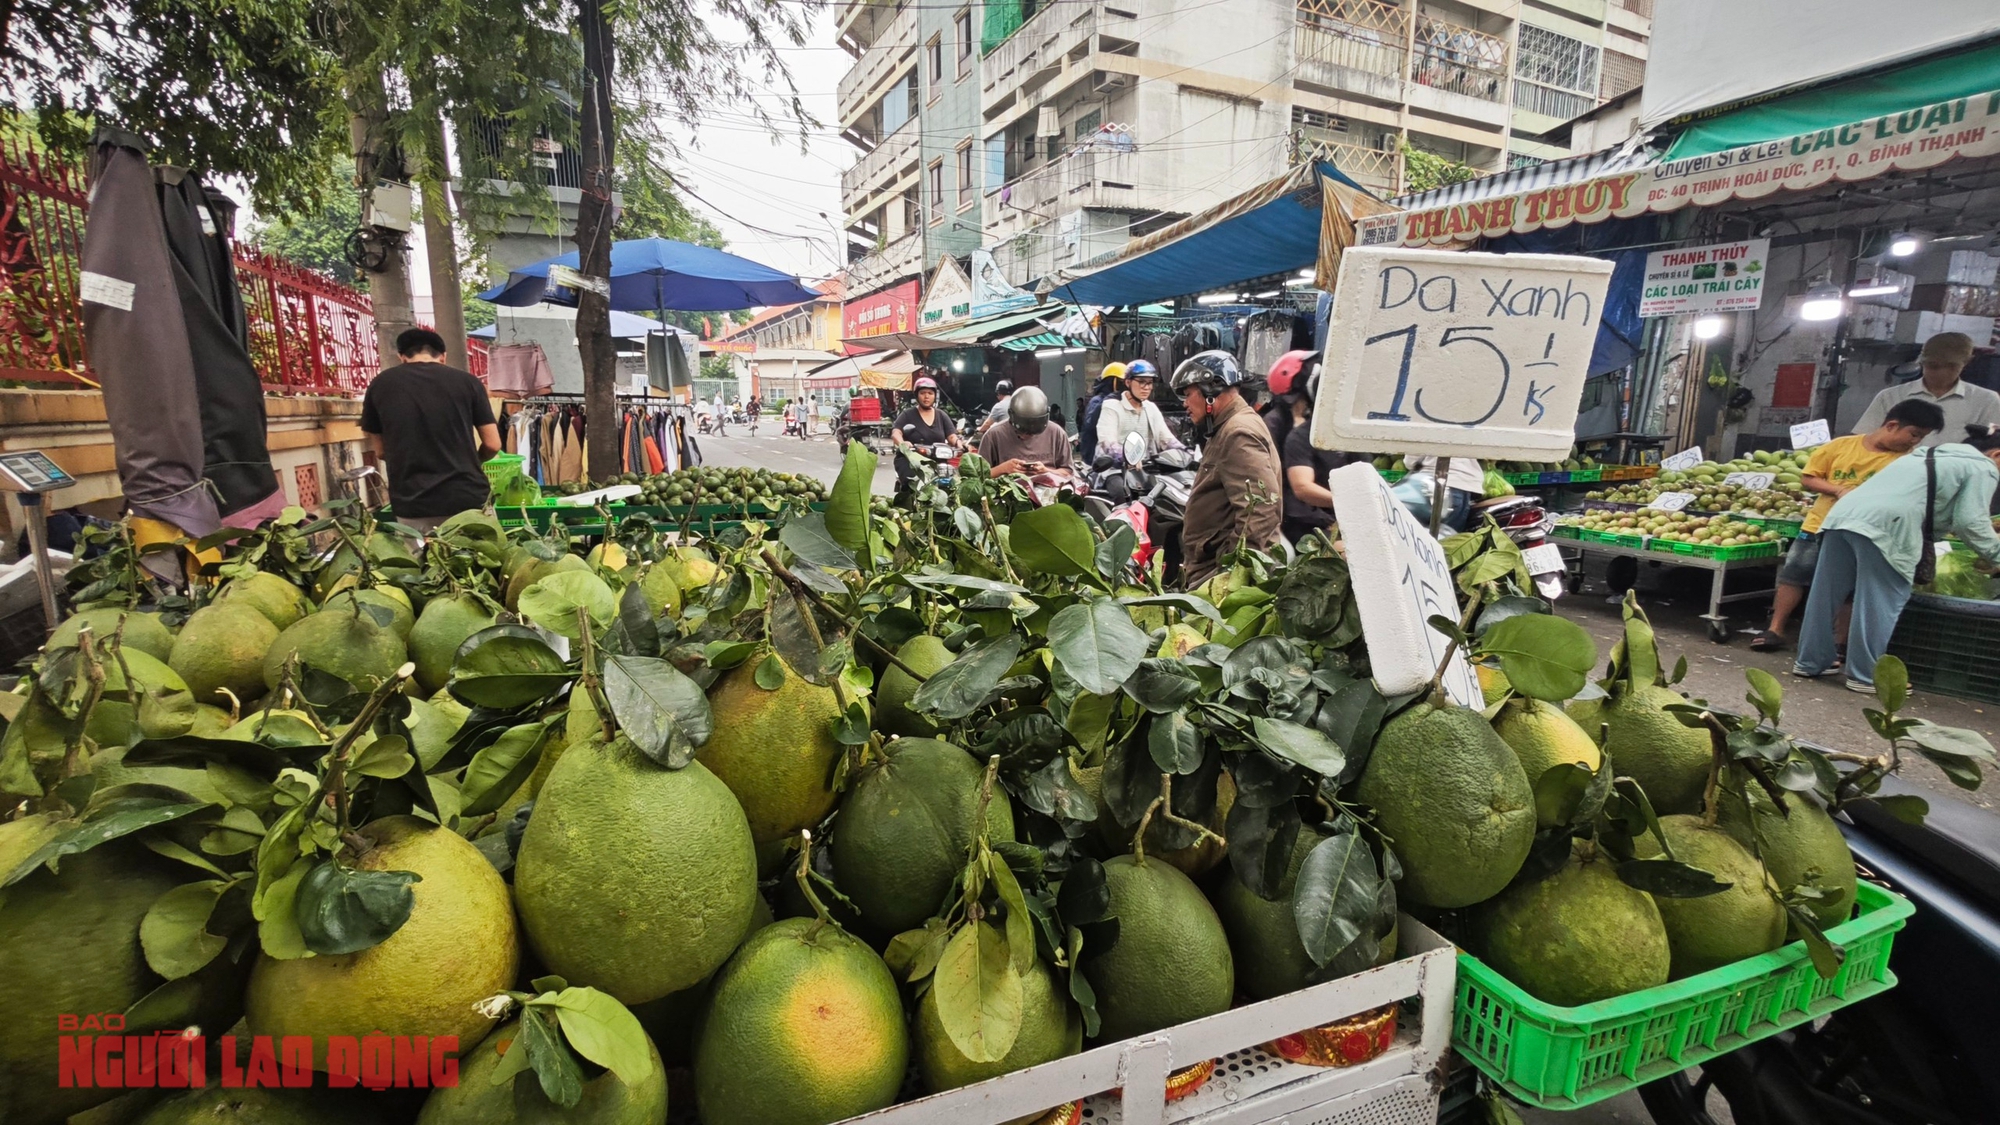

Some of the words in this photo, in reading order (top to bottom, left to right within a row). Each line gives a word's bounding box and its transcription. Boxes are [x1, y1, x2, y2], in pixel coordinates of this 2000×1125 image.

[1671, 184, 1687, 197] 40
[1692, 177, 1730, 195] TRỊNH
[1734, 168, 1768, 191] HOÀI
[1772, 161, 1807, 180] ĐỨC,
[1847, 152, 1862, 167] Q.
[1868, 141, 1913, 162] BÌNH
[1920, 127, 1986, 152] THẠNH
[1405, 195, 1519, 240] THANH
[1662, 250, 1706, 266] THANH
[1379, 266, 1457, 313] Da
[1645, 284, 1668, 298] CÁC
[1672, 284, 1698, 298] LOẠI
[1702, 279, 1730, 294] TRÁI
[1734, 276, 1760, 291] CÂY
[1364, 323, 1510, 428] 15
